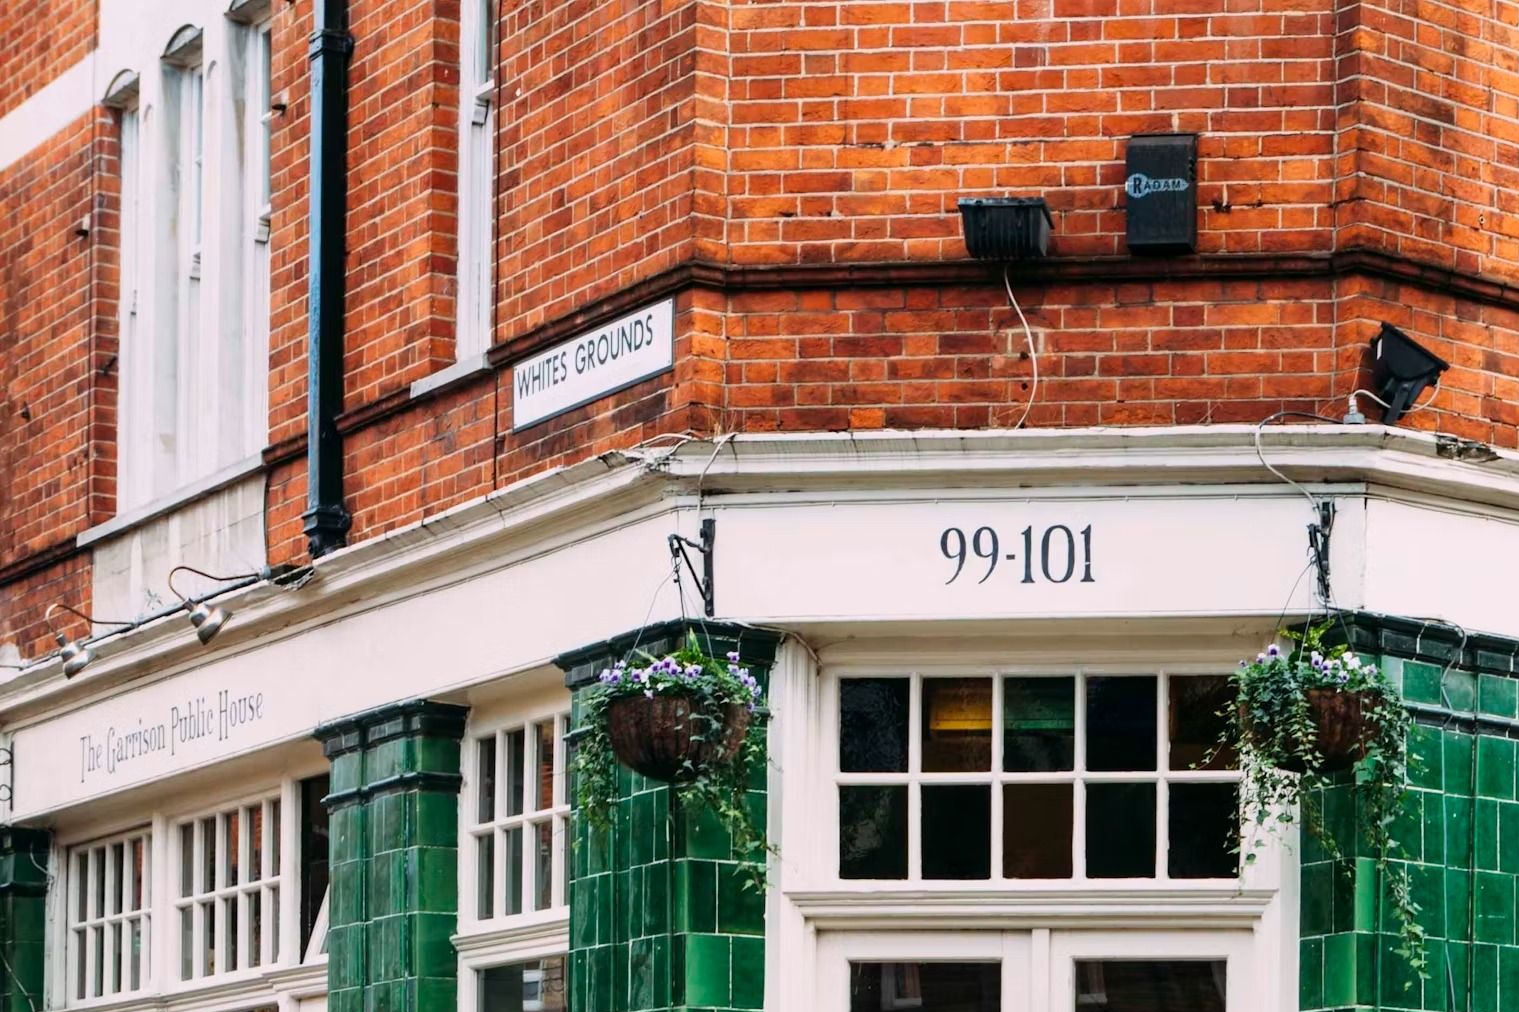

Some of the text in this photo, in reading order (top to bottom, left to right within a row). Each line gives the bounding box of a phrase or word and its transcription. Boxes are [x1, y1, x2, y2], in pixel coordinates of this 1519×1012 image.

[517, 314, 654, 399] WHITES GROUNDS
[940, 524, 1096, 585] 99-101
[80, 689, 263, 783] The Garrison Public House
